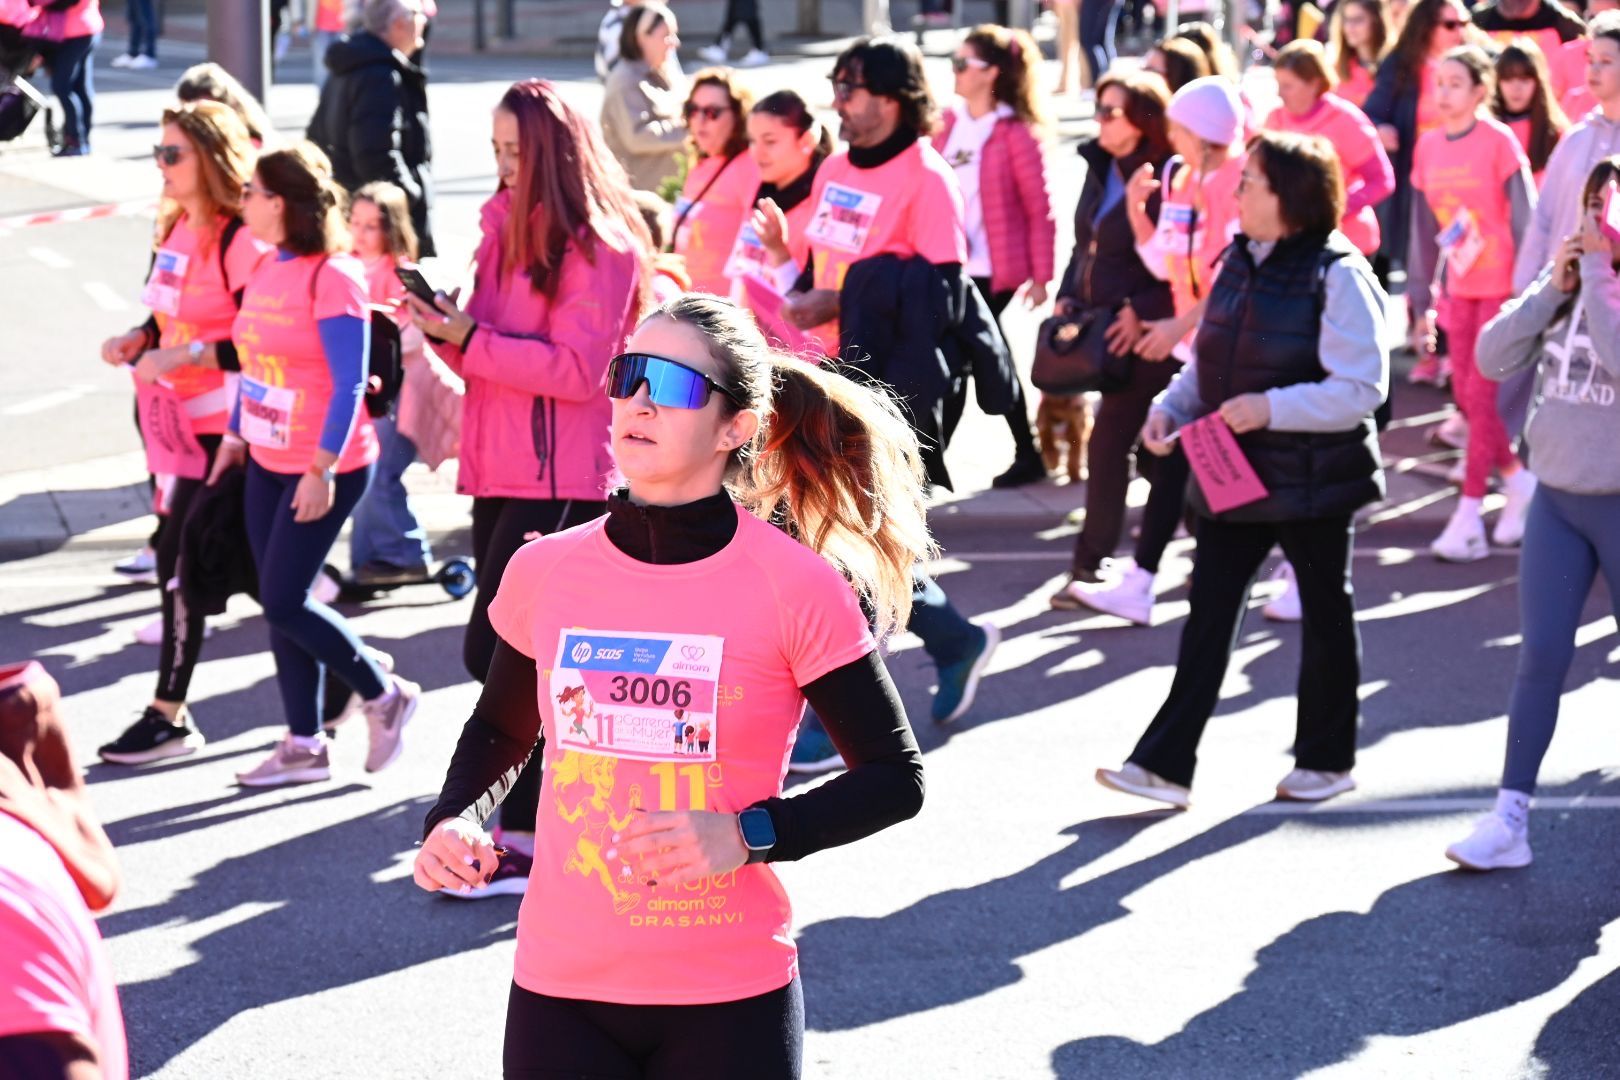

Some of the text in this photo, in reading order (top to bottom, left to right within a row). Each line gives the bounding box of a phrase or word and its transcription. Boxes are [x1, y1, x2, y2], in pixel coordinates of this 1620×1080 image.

[572, 641, 592, 664] hp
[672, 663, 710, 673] almom
[609, 666, 692, 708] 3006
[647, 897, 705, 912] almom
[629, 911, 744, 928] DRASANVI
